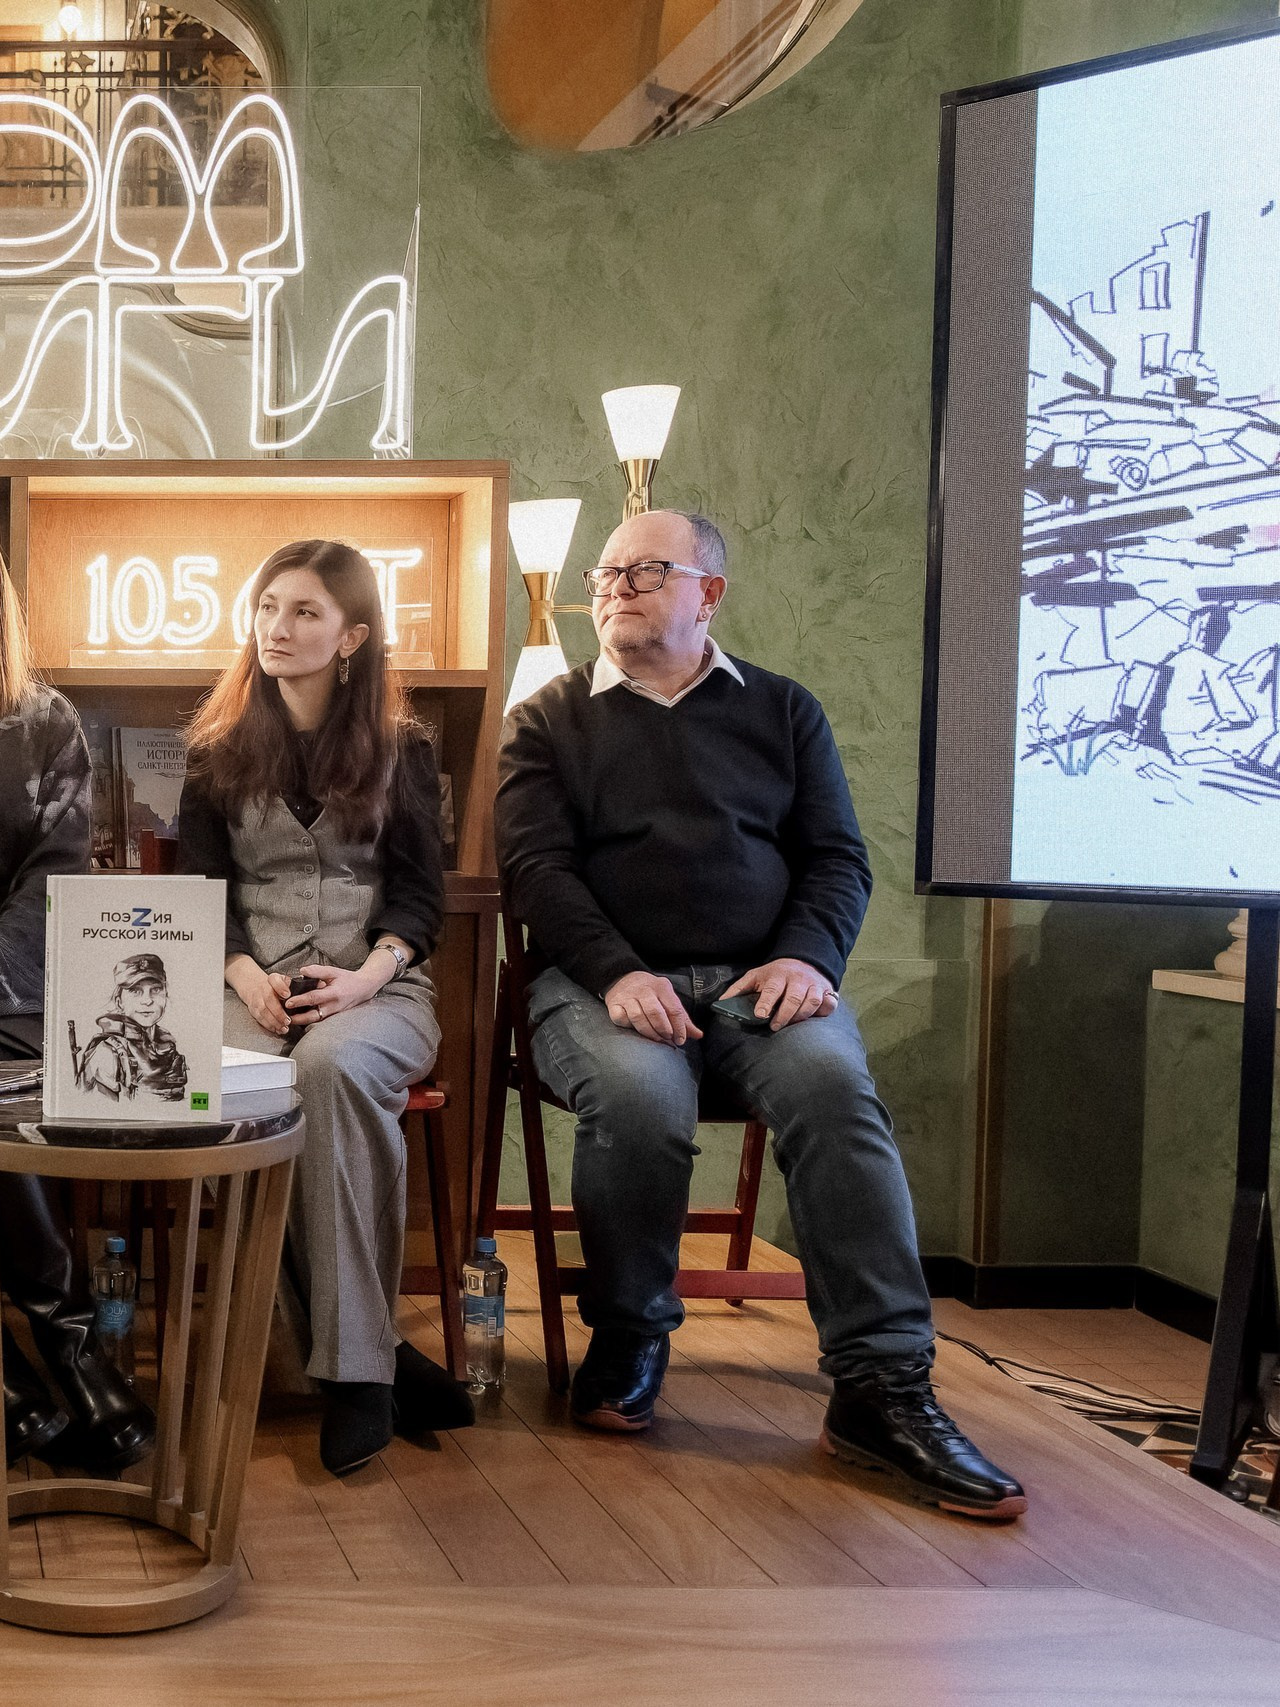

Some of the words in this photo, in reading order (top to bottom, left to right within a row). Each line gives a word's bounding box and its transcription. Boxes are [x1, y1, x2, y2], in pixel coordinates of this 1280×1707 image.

[85, 553, 221, 645] 105
[137, 761, 186, 770] САНКТ-ПЕТЕР
[82, 927, 146, 941] РУССКОЙ
[150, 930, 194, 941] ЗИМЫ
